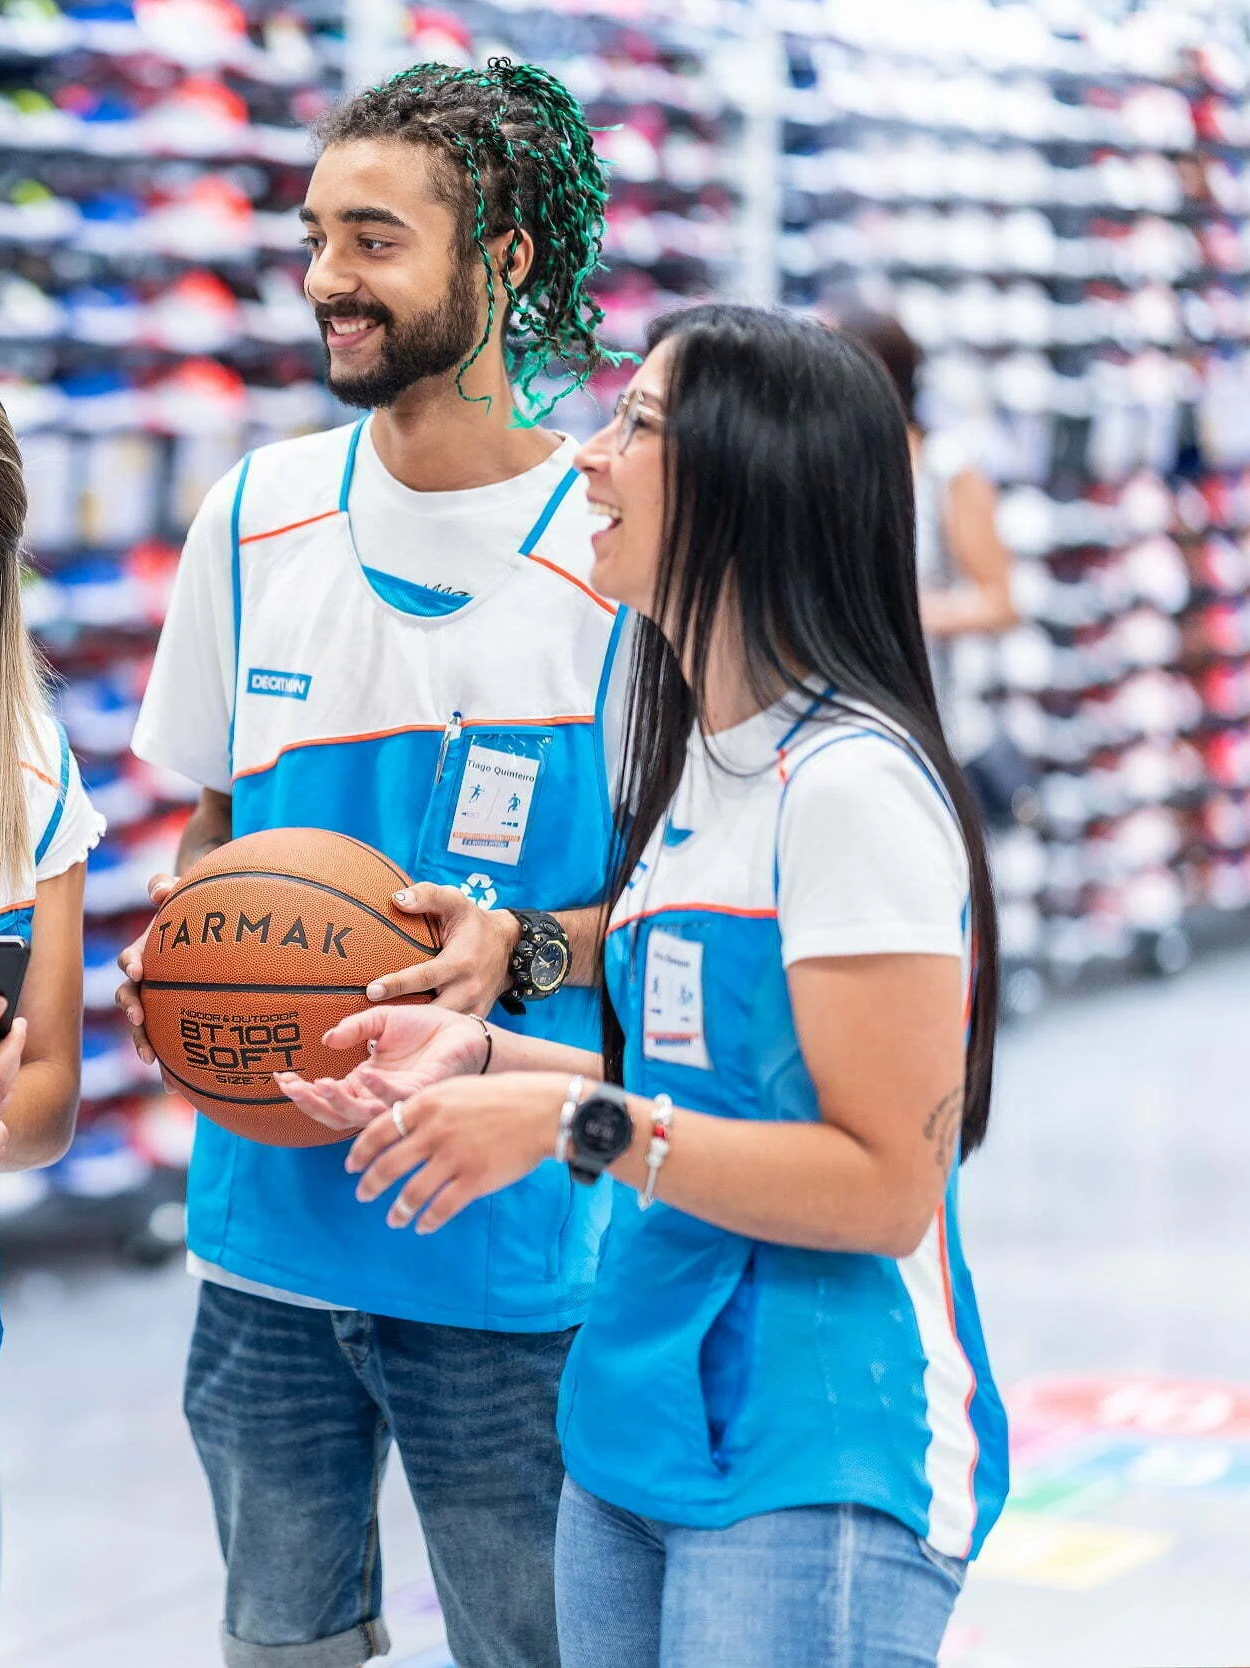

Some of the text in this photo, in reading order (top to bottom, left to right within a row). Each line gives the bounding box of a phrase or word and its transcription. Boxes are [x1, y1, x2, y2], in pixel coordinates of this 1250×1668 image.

[468, 760, 535, 783] Tiago Quinteiro
[159, 911, 354, 959] TARMAK
[232, 1011, 299, 1022] OUTDOOR
[181, 1019, 301, 1045] BT 100
[183, 1041, 303, 1069] SOFT
[215, 1074, 272, 1085] SIZE 7
